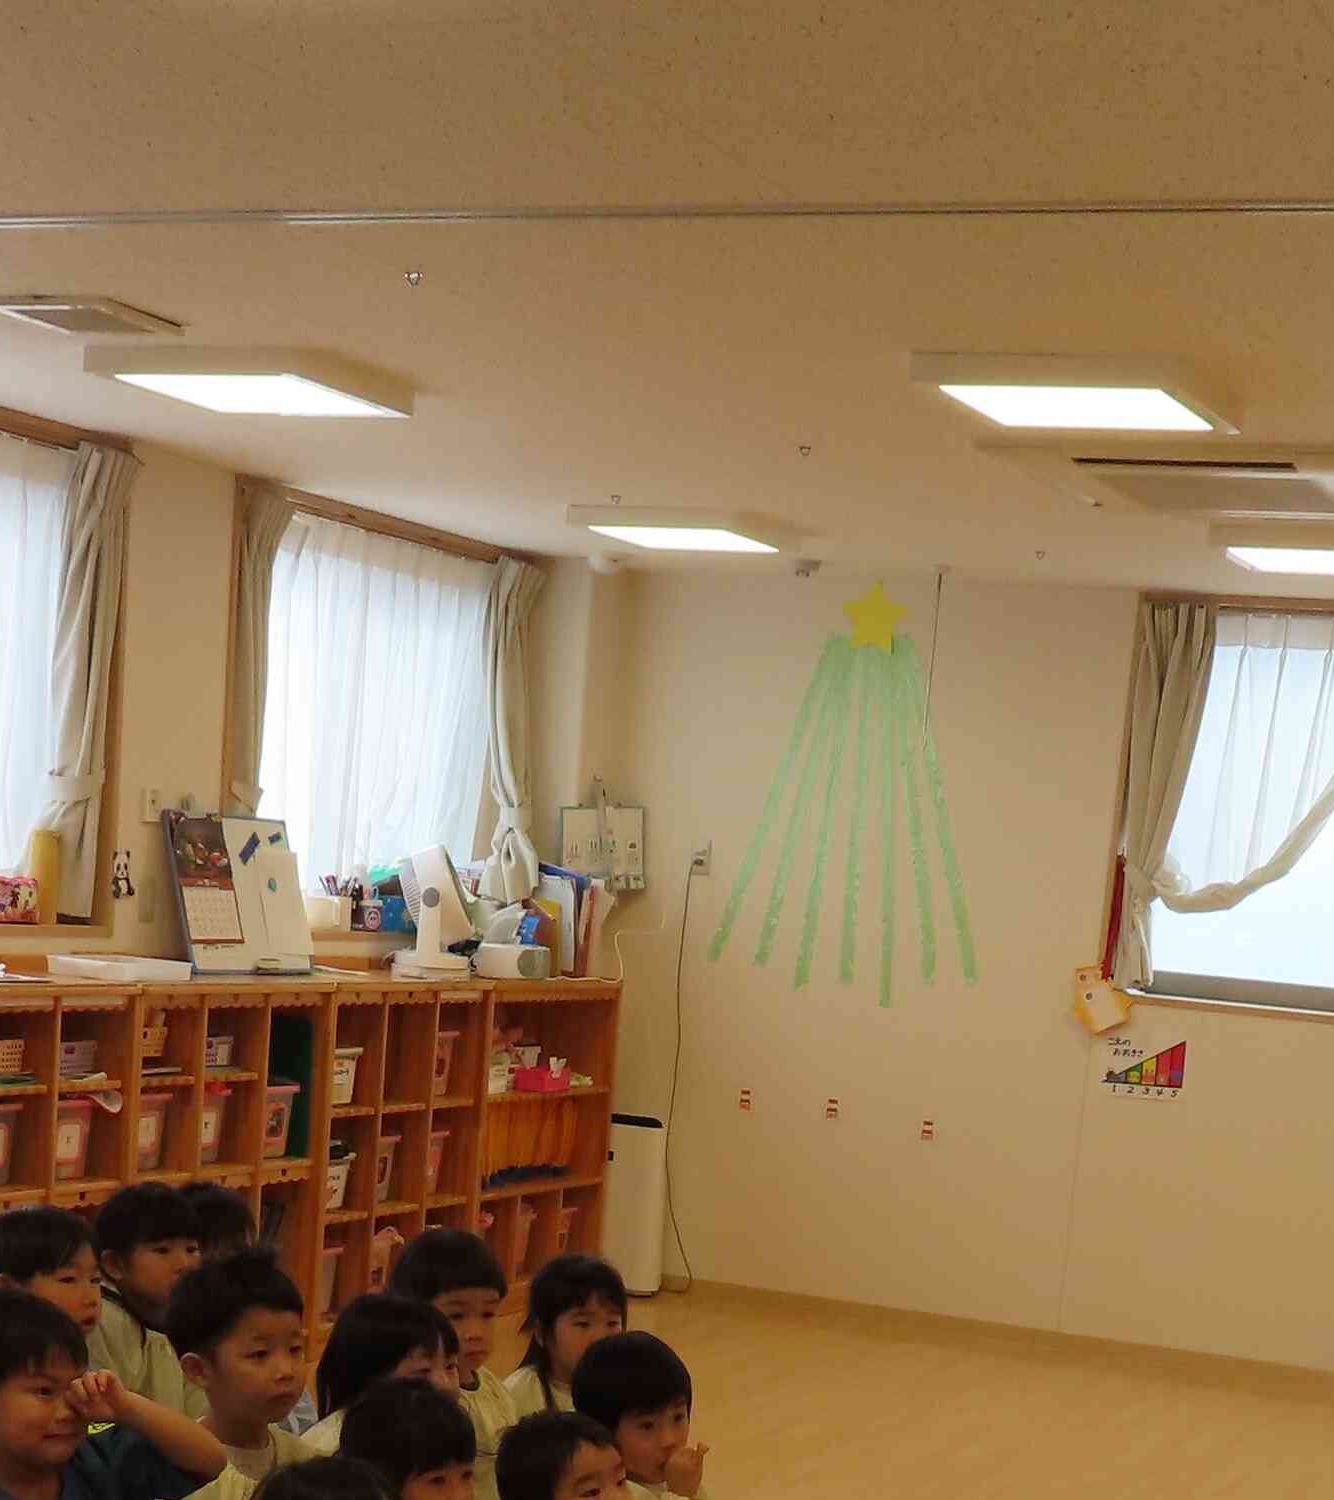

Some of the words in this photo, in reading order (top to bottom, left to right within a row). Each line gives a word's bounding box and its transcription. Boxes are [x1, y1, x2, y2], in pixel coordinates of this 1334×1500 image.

[1126, 1086, 1135, 1094] 2
[1142, 1087, 1151, 1095] 3
[1156, 1088, 1164, 1097] 4
[1170, 1089, 1180, 1098] 5
